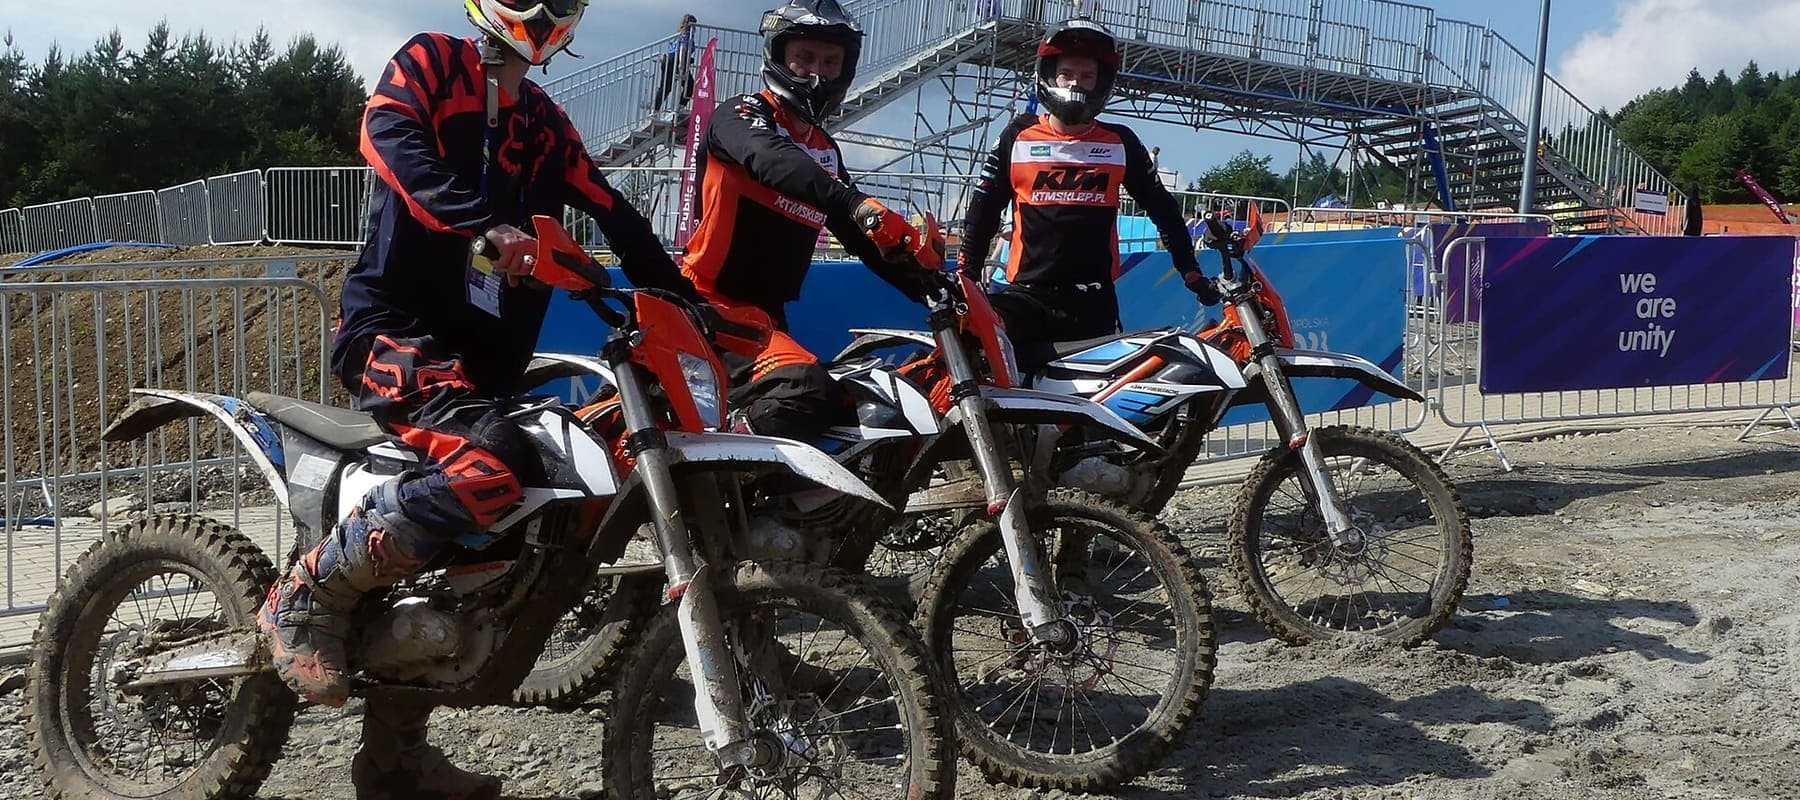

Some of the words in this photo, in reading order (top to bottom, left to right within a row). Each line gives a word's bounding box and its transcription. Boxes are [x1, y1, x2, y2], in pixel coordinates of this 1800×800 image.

[1032, 166, 1110, 190] KTM
[680, 184, 695, 232] Public
[1031, 191, 1106, 203] KTMSKLEP.PL
[1619, 272, 1657, 294] we
[1635, 297, 1677, 319] are
[1618, 322, 1676, 358] unity
